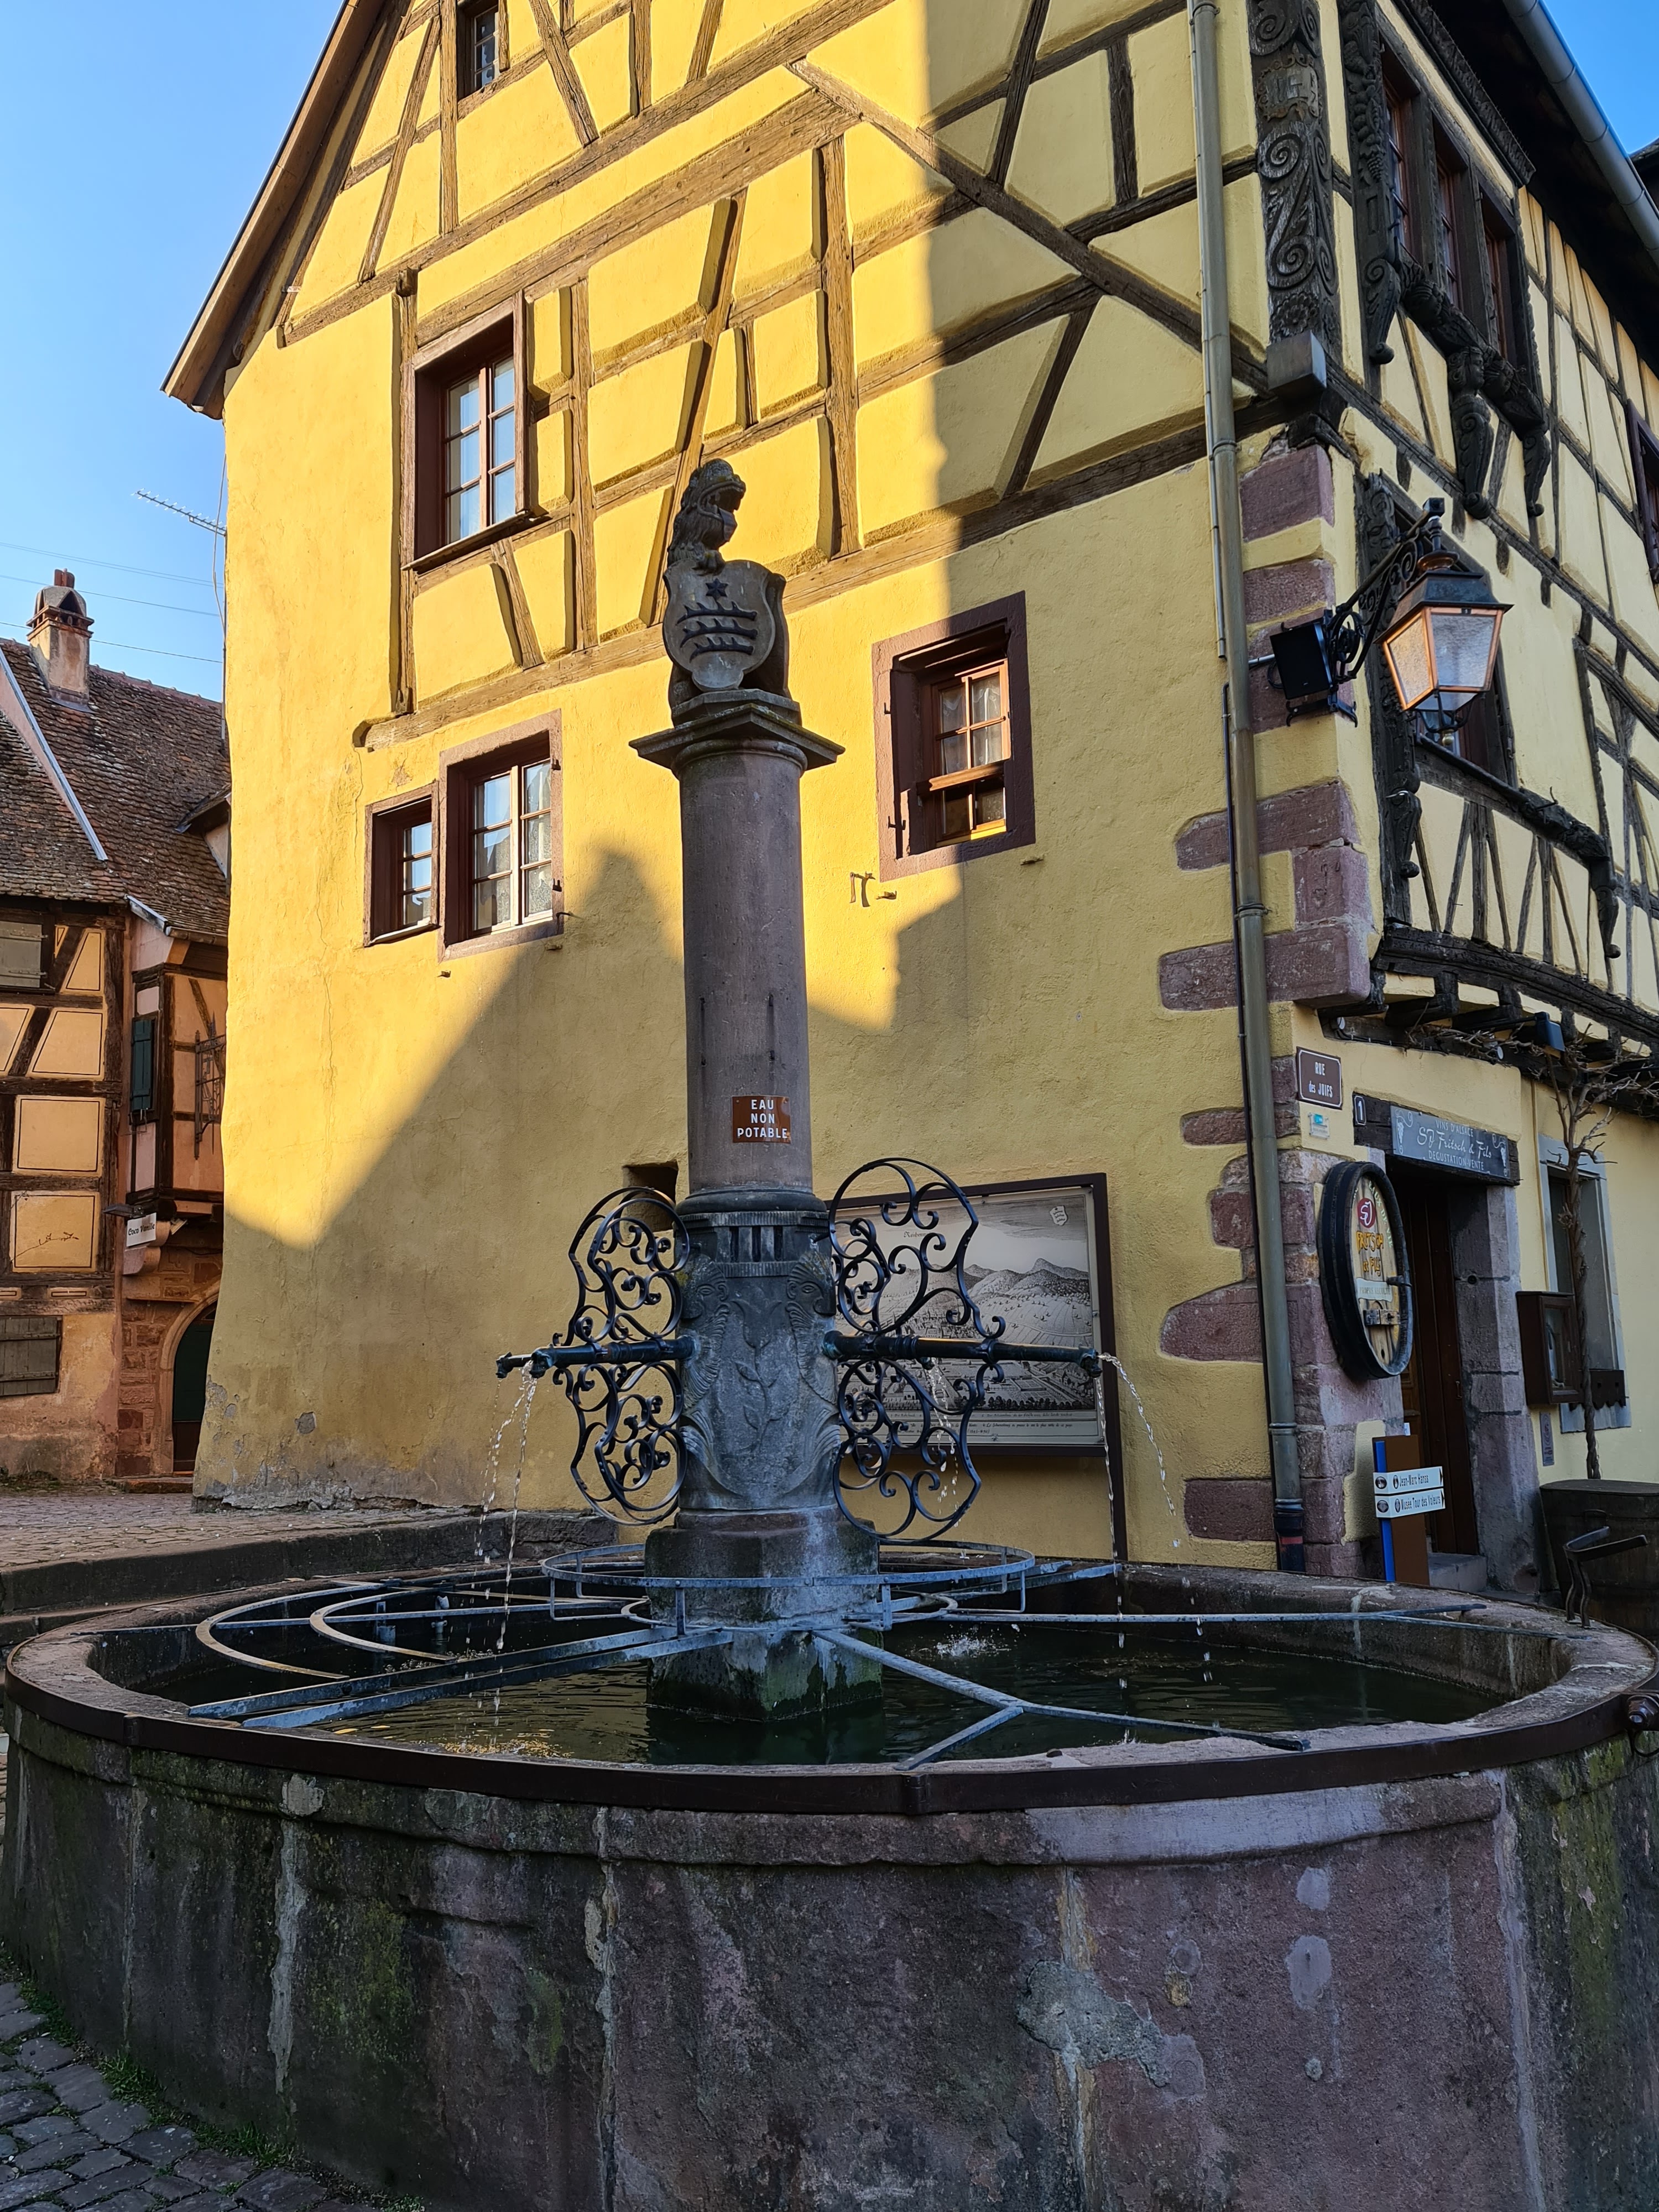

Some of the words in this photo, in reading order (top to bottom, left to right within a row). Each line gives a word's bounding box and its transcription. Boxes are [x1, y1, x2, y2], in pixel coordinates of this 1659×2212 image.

[1315, 1062, 1326, 1076] RUE
[1318, 1083, 1333, 1098] JUIFS
[751, 1099, 774, 1109] EAU
[1358, 1100, 1363, 1120] 1
[751, 1113, 775, 1124] NON
[737, 1127, 787, 1139] POTABLE
[1436, 1120, 1448, 1131] VINS
[1451, 1123, 1474, 1138] D'ALSACE
[1436, 1130, 1465, 1152] Fritsch
[1469, 1144, 1474, 1154] &
[1476, 1140, 1492, 1160] Fils
[1356, 1230, 1384, 1255] FRITSCH
[1412, 1497, 1421, 1509] Tour
